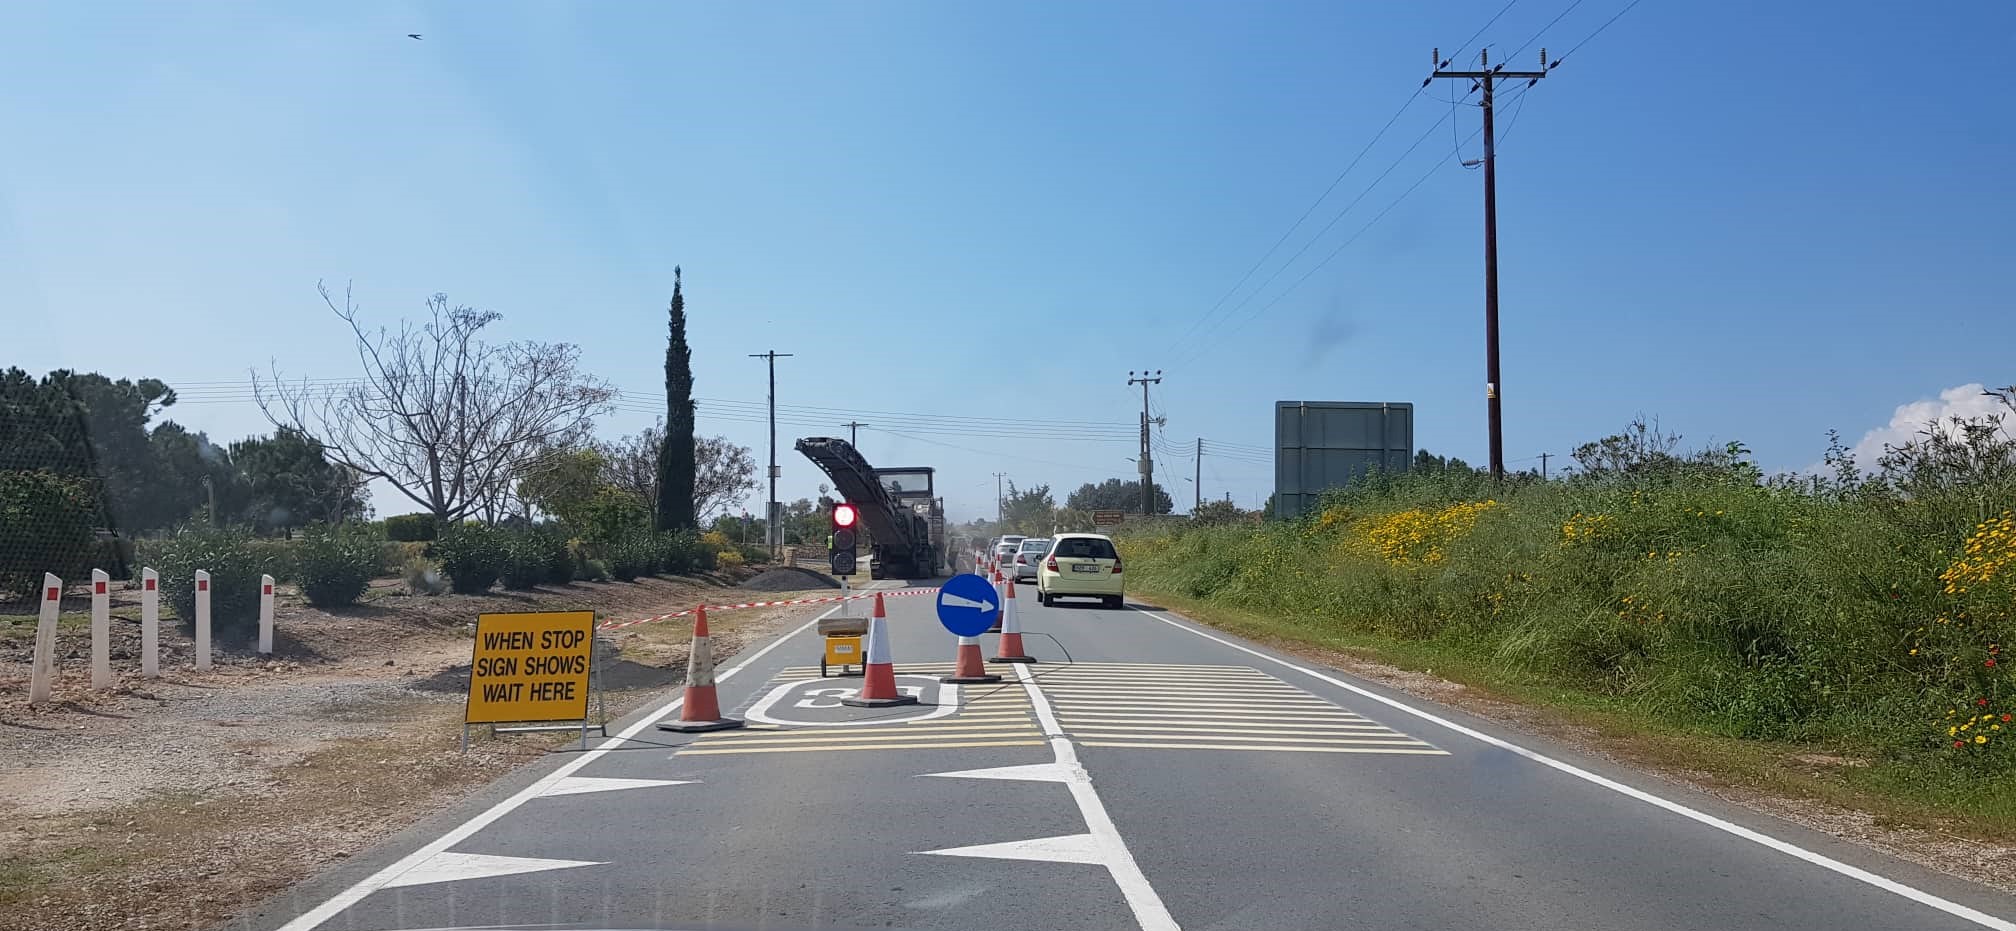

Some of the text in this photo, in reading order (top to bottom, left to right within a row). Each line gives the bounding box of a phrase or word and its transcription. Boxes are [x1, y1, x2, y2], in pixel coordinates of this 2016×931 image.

[484, 630, 585, 650] WHEN STOP
[476, 655, 585, 677] SIGN SHOWS
[483, 681, 576, 703] WAIT HERE
